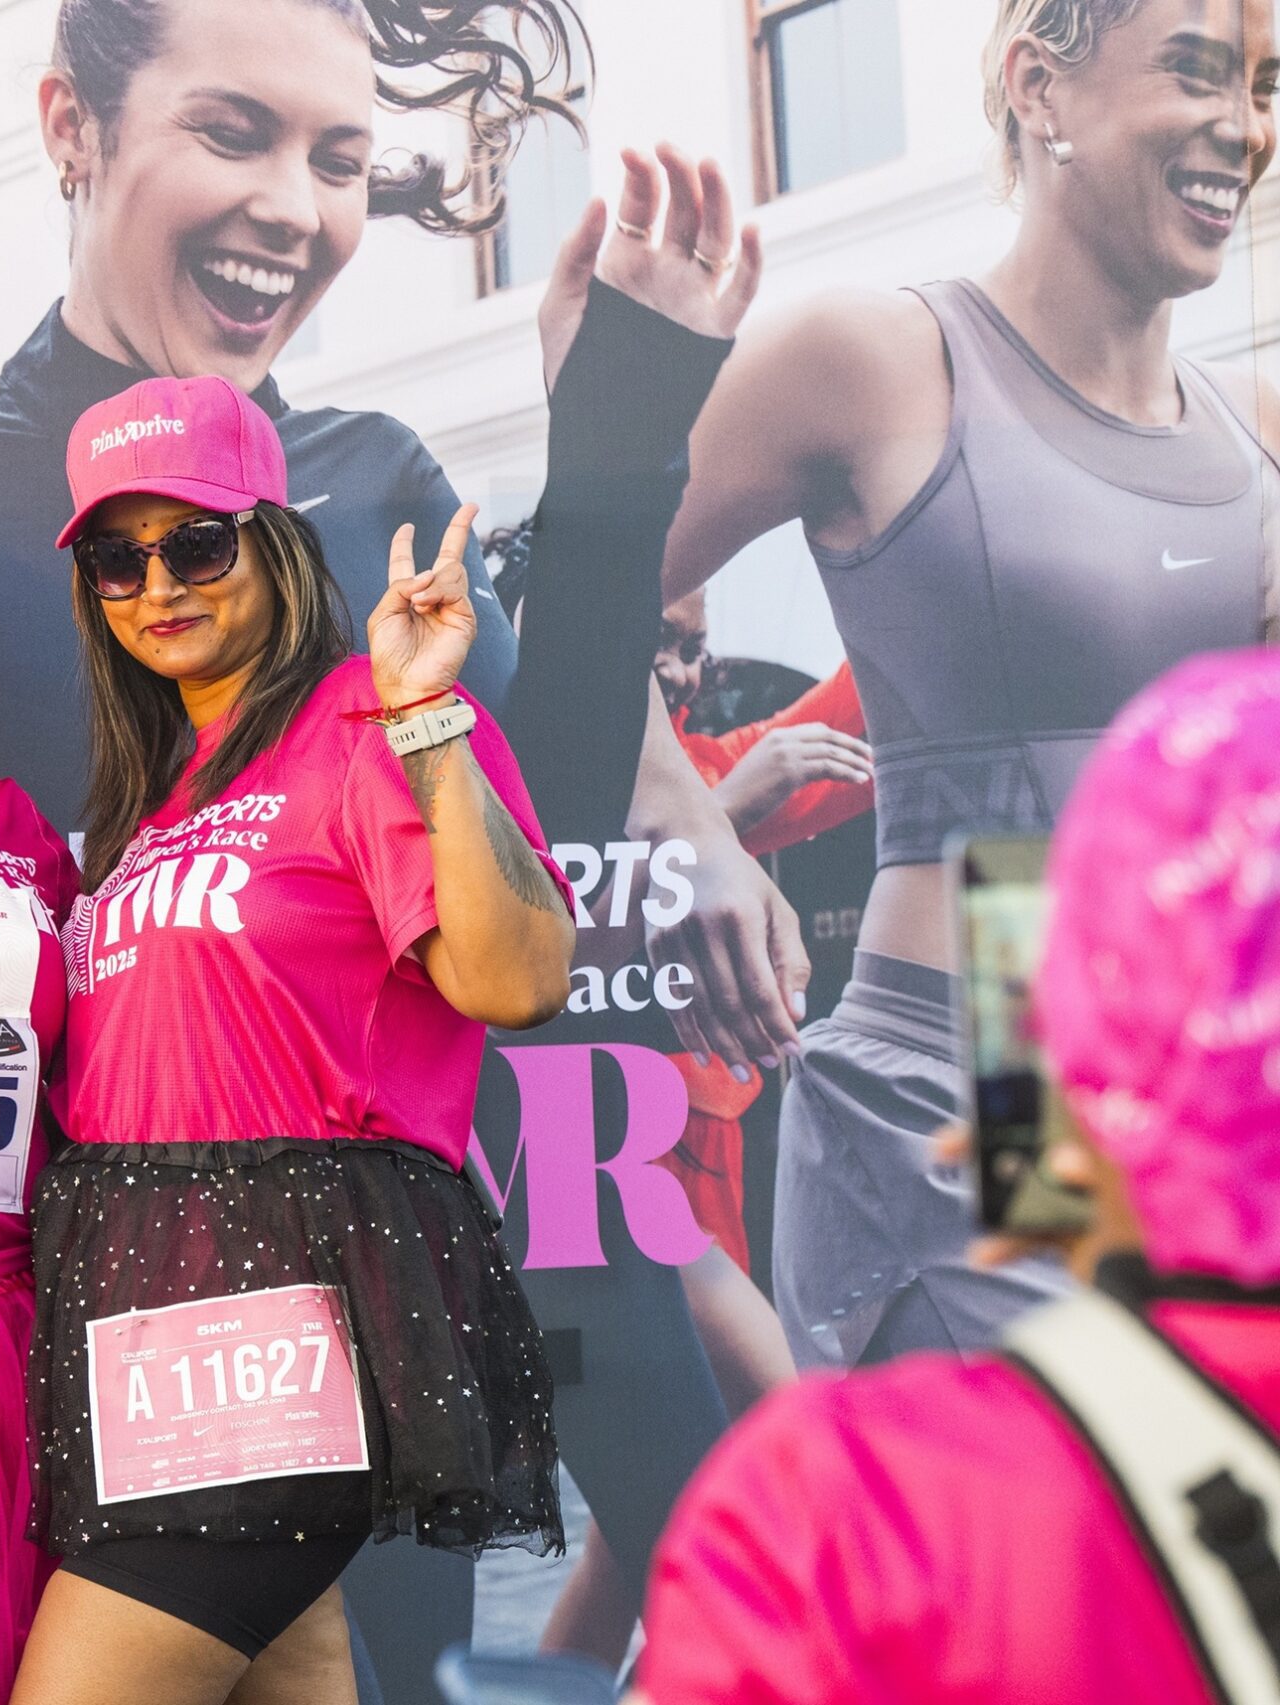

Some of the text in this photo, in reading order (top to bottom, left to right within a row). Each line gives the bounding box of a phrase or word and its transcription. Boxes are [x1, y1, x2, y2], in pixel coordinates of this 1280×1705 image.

[202, 828, 268, 851] Race
[104, 853, 251, 947] TWR
[95, 945, 138, 982] 2025
[561, 961, 695, 1014] ace
[196, 1319, 243, 1336] 5KM
[127, 1335, 330, 1423] A 11627
